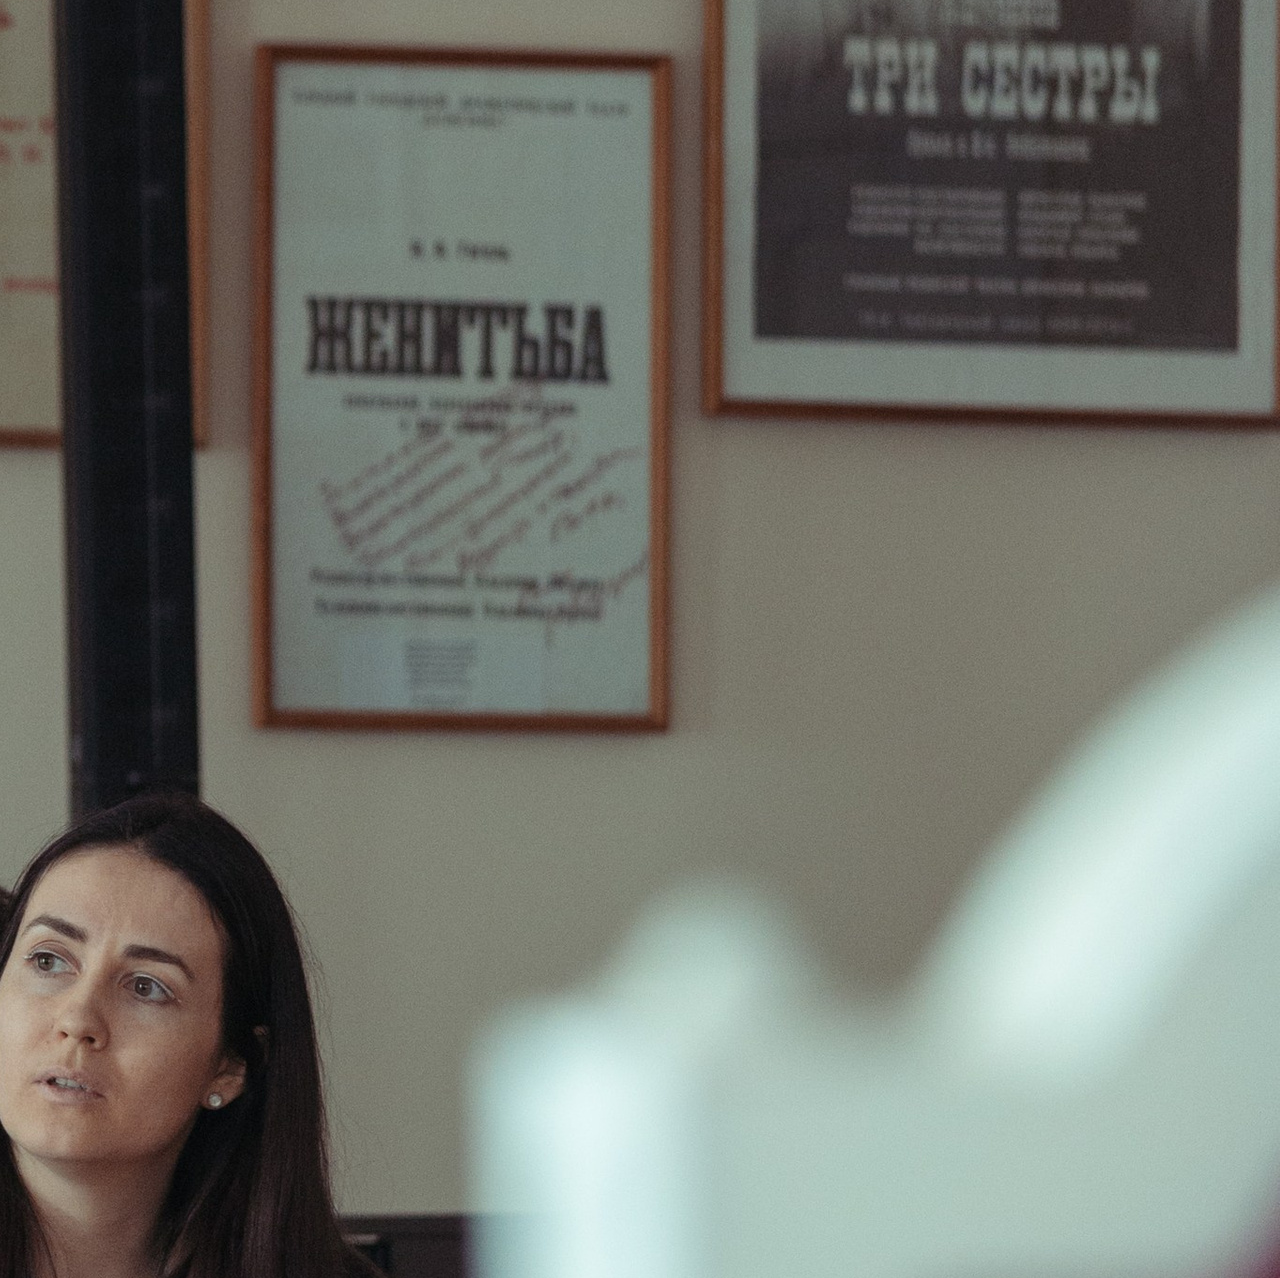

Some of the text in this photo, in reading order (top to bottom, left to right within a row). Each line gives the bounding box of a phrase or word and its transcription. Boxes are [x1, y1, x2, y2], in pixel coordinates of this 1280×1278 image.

[842, 36, 1161, 124] ТРИ СЕСТРЫ
[305, 294, 610, 385] ЖЕНИТЬБА
